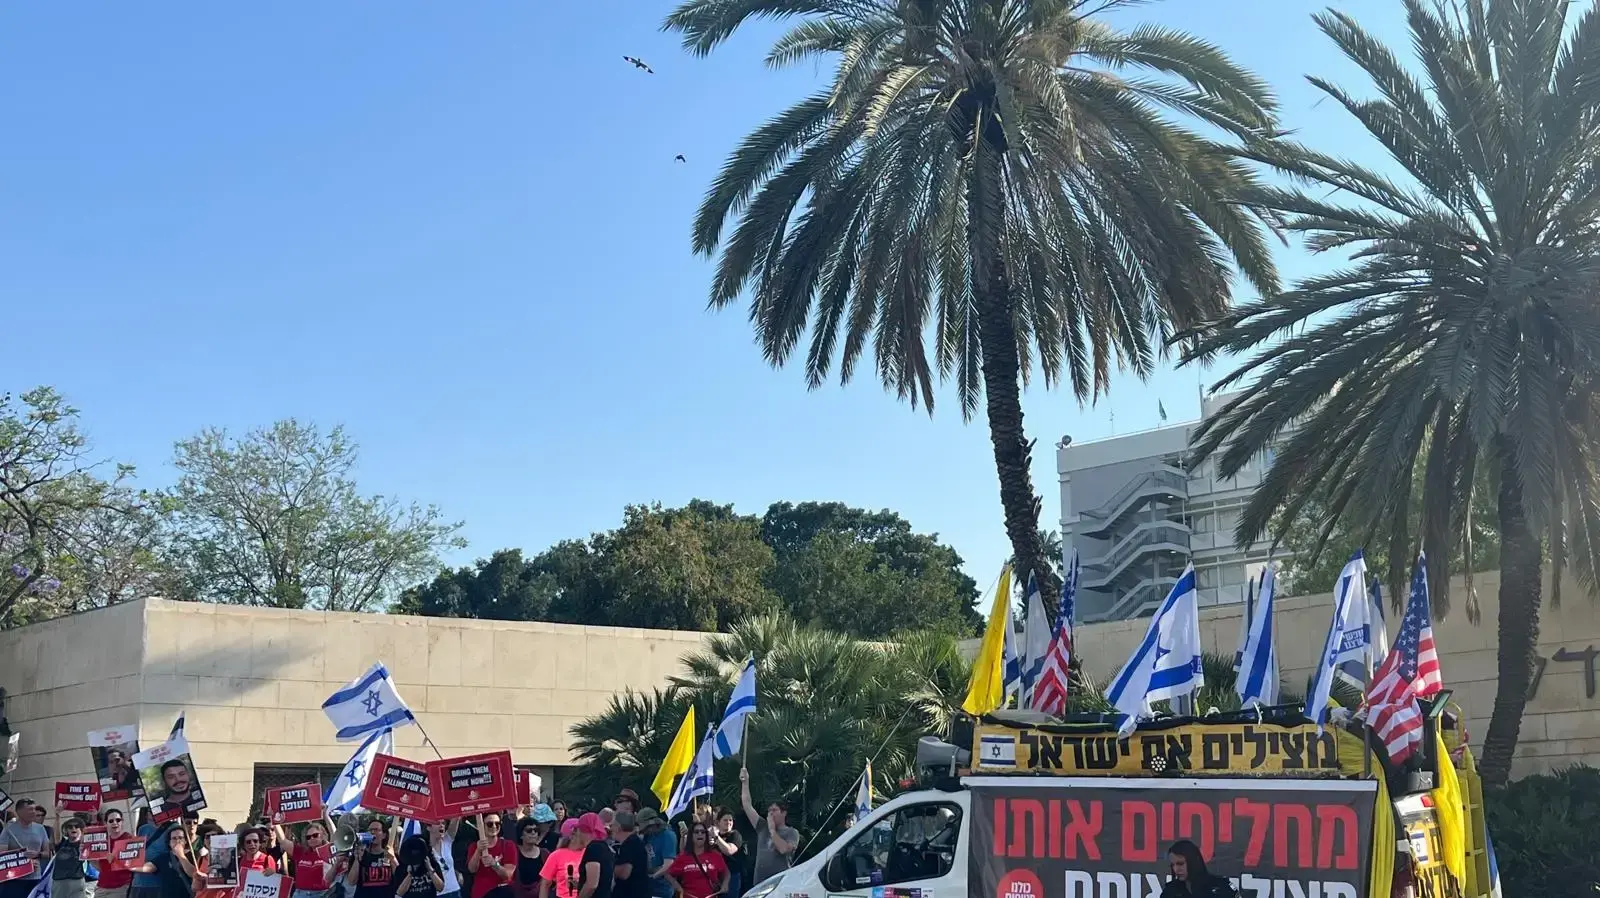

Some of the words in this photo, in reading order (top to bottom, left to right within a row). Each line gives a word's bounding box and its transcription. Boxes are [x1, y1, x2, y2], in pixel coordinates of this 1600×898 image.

[1020, 731, 1130, 769] ישראל
[1141, 734, 1192, 769] את
[1202, 726, 1339, 770] מצילים
[387, 768, 400, 776] OUR
[400, 771, 424, 783] SISTERS
[452, 769, 471, 778] BRING
[472, 765, 489, 775] THEM
[383, 777, 406, 789] CALLING
[406, 783, 419, 792] FOR
[451, 779, 469, 788] HOME
[281, 789, 308, 800] מדינה
[280, 800, 310, 811] חטופה
[993, 799, 1104, 861] אותו
[1122, 798, 1359, 870] מחליפים
[246, 883, 278, 897] עסקה
[1010, 881, 1032, 894] כולנו
